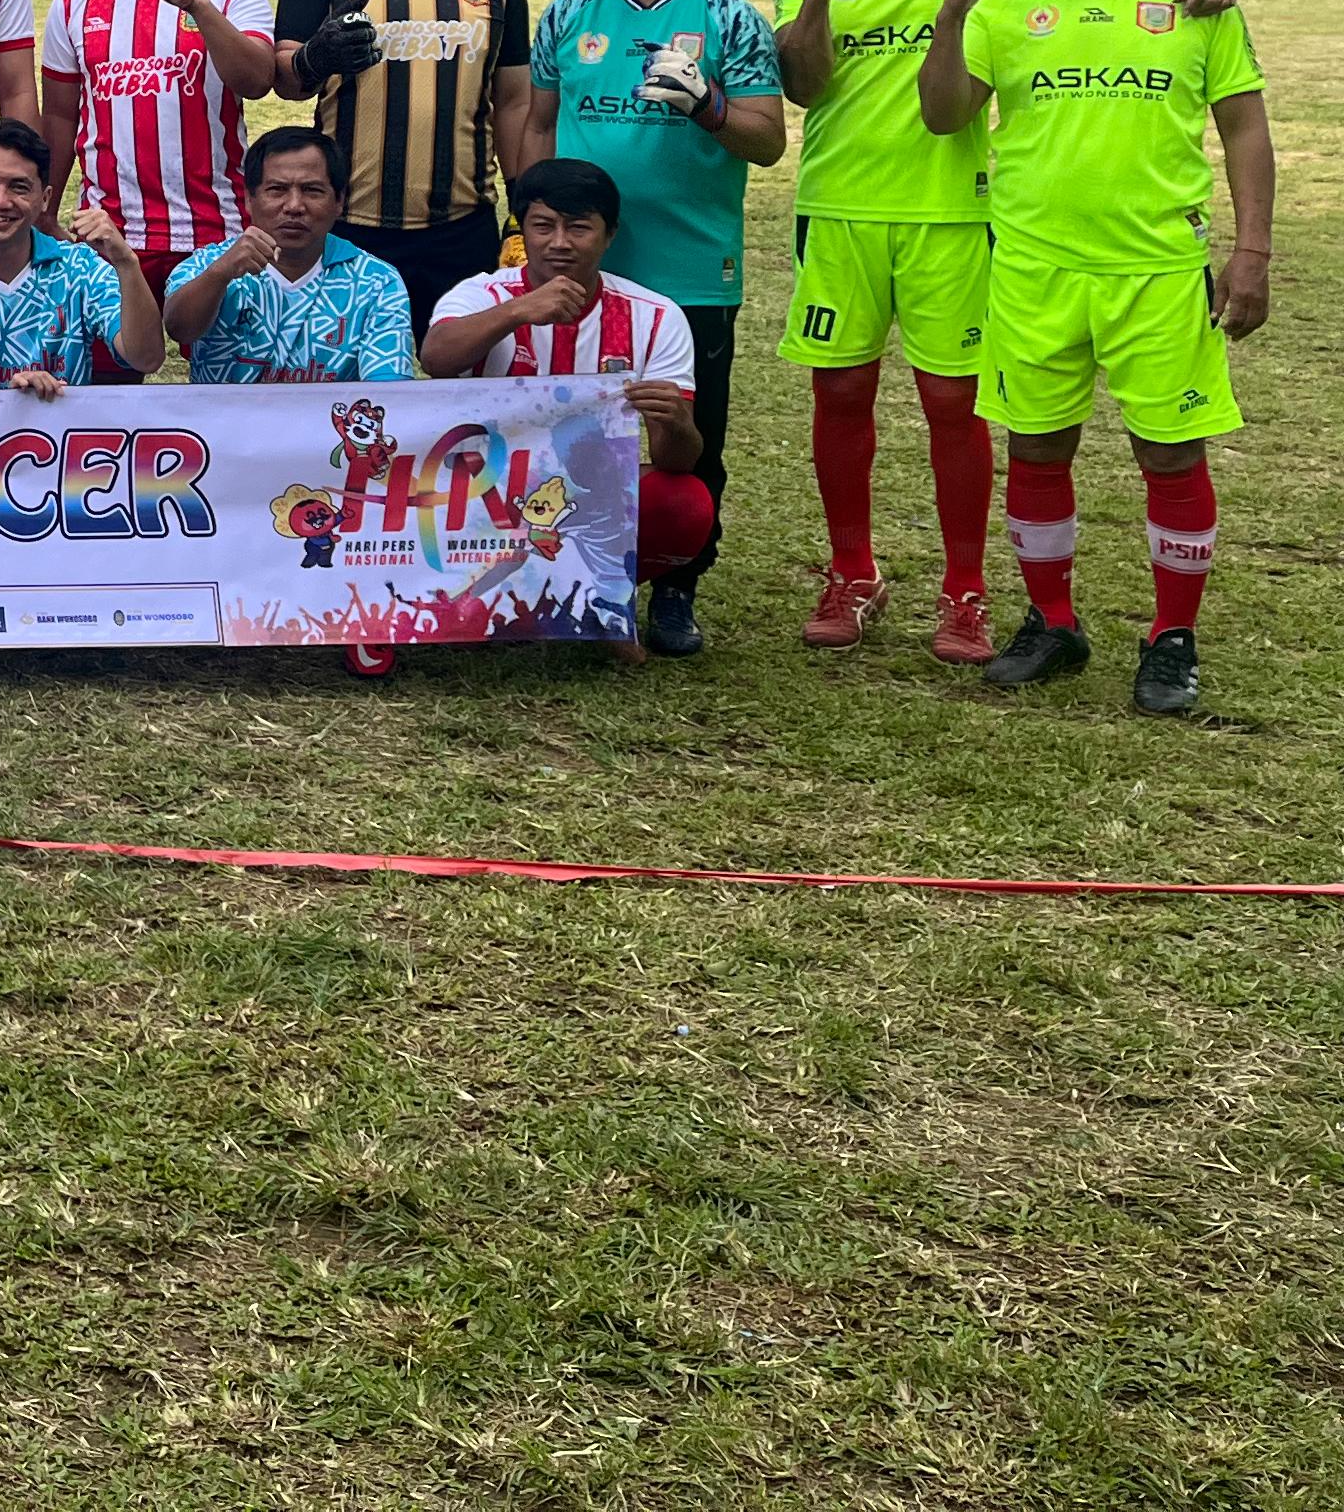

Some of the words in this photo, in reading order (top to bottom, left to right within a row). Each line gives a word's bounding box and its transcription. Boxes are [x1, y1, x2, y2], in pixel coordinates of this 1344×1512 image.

[843, 24, 934, 49] ASKA
[874, 46, 929, 57] WONOS
[95, 53, 186, 76] WONOSOBO
[1031, 67, 1173, 92] ASKAB
[1035, 92, 1065, 102] PSSI
[1071, 90, 1165, 102] WONOSOBO
[802, 304, 837, 342] 10
[345, 540, 377, 552] HARI
[382, 540, 415, 552] PERS
[447, 538, 527, 551] WONOSOBO
[344, 553, 415, 566] NASIONAL
[446, 552, 491, 565] JATENG
[37, 615, 55, 624] BANK
[57, 614, 98, 623] WONOSOBO
[144, 613, 194, 621] WONOSOBO
